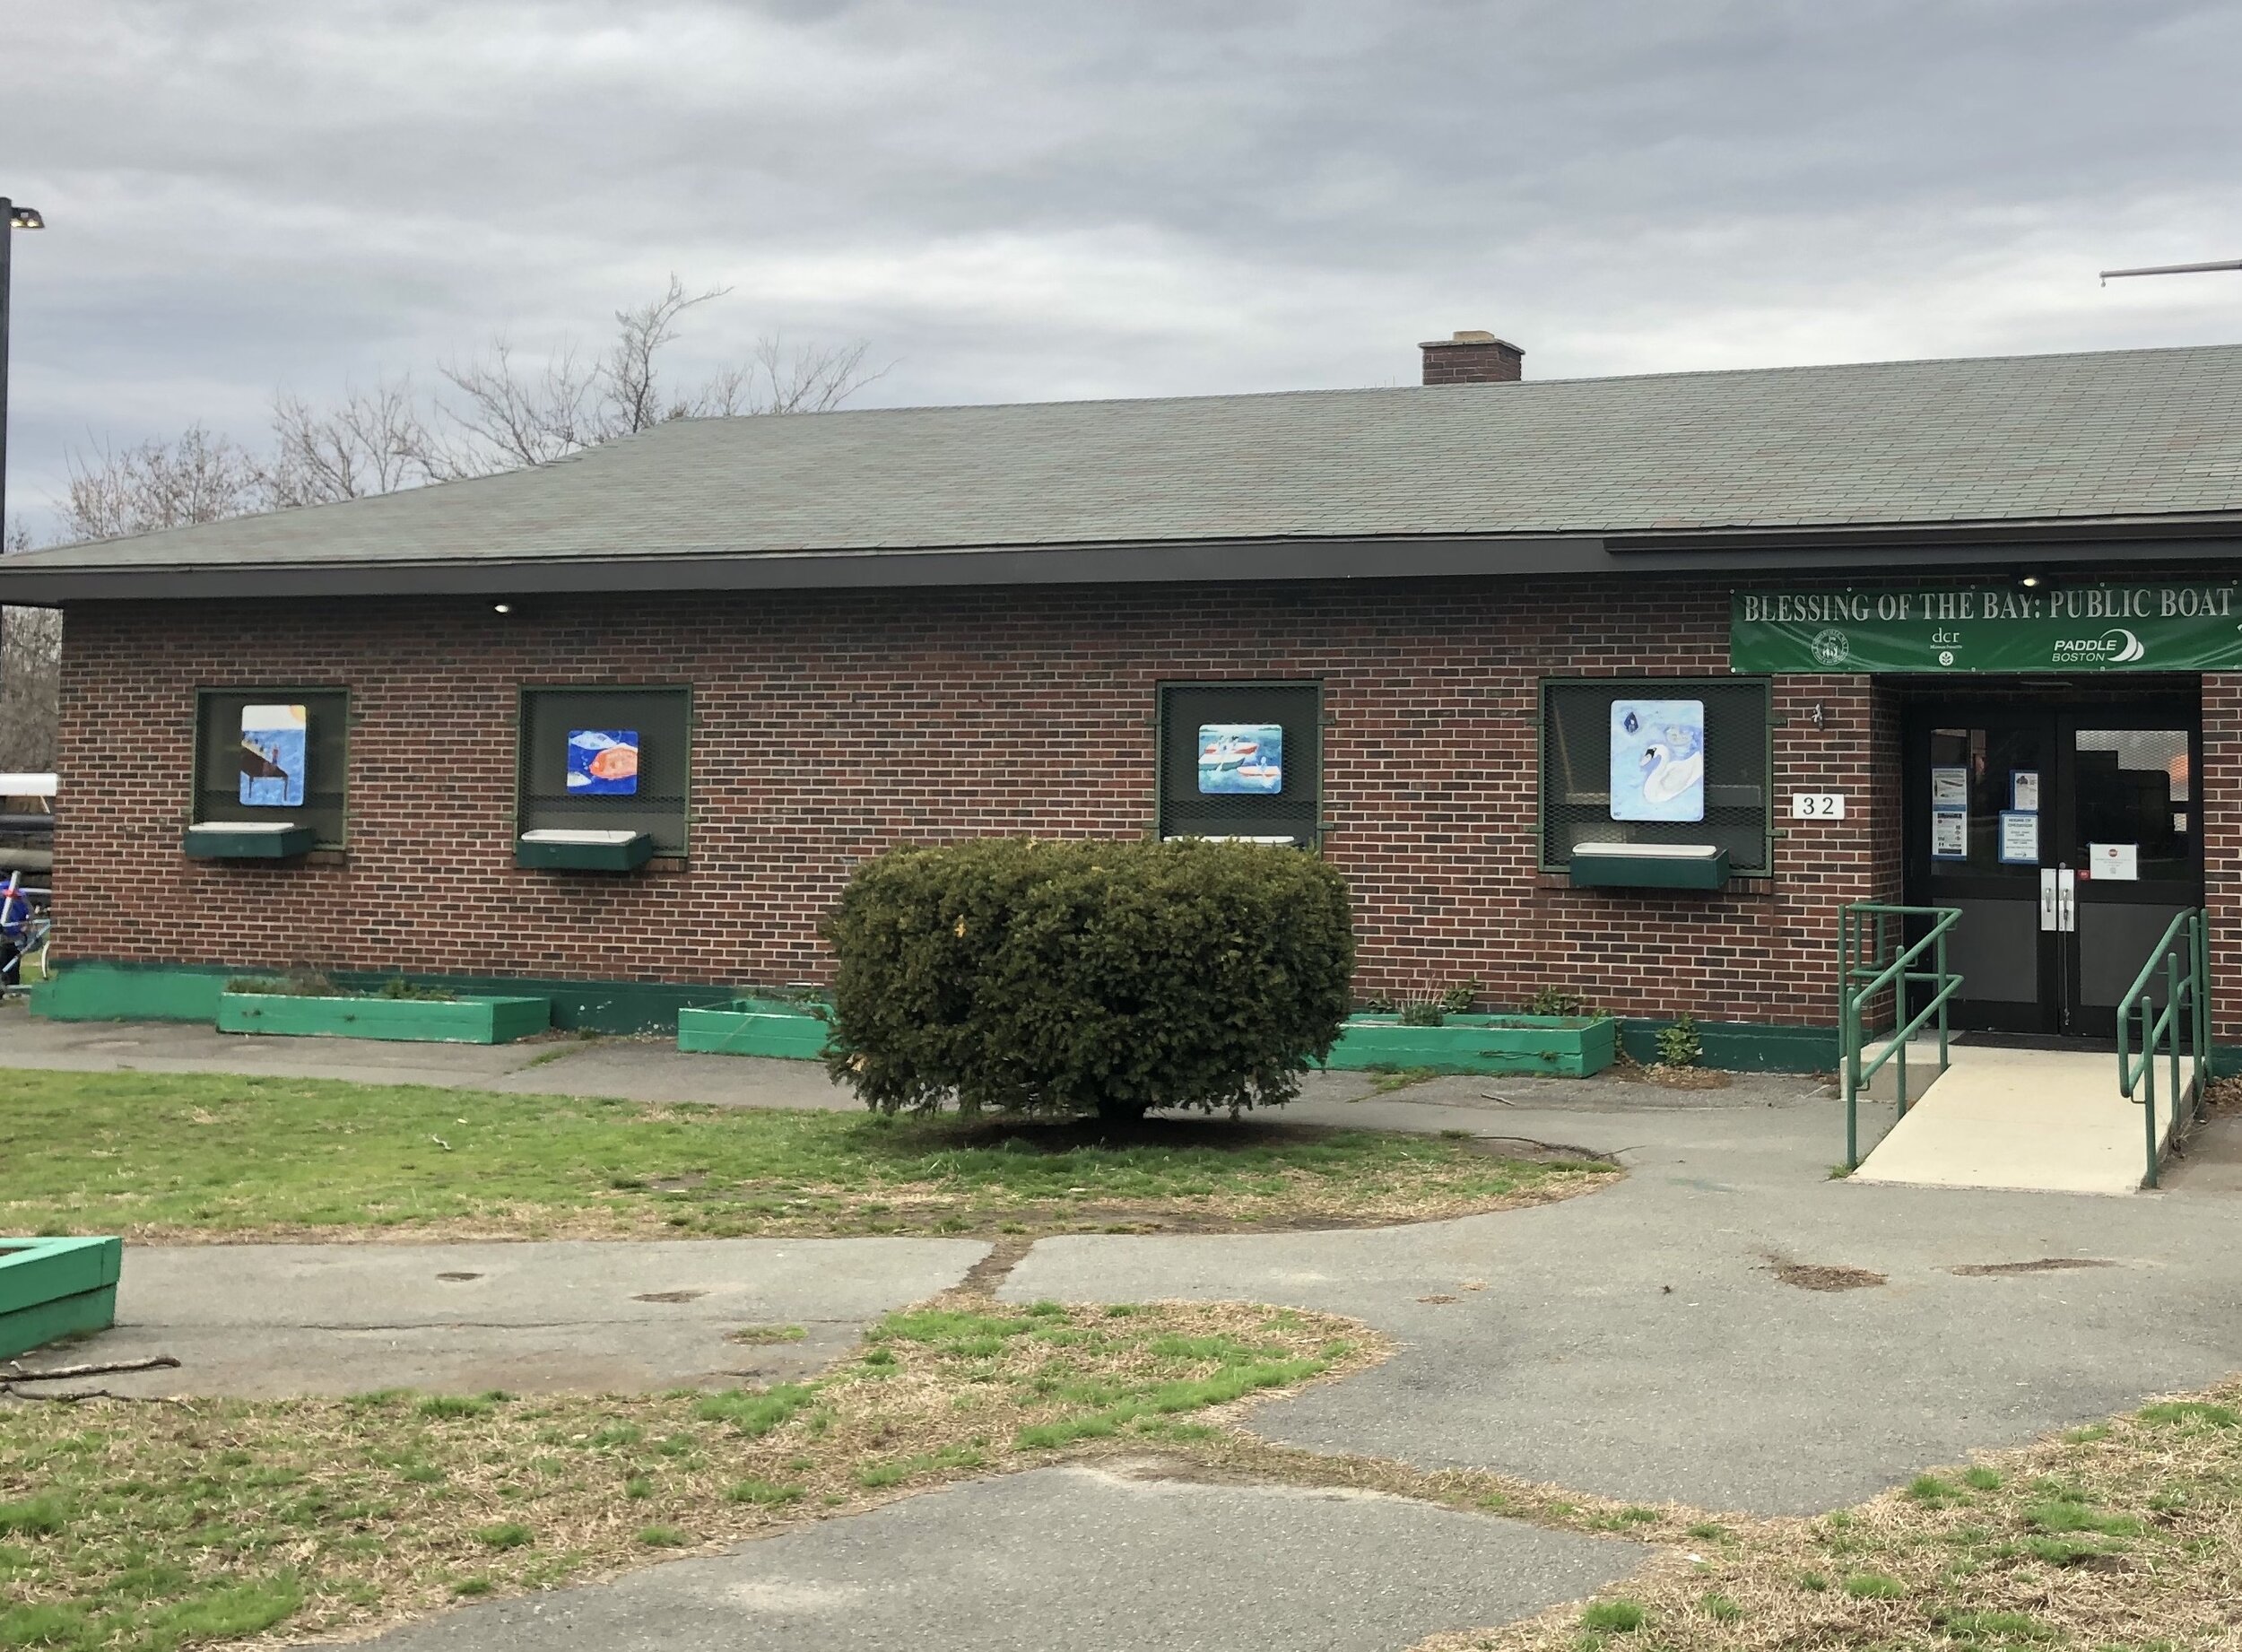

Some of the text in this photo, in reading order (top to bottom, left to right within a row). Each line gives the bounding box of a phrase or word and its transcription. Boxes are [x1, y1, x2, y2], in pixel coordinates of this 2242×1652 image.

[1743, 587, 2234, 622] BLESSING OF THE BAY: PUBLIC BOAT
[1932, 627, 1960, 643] dcr
[2054, 639, 2117, 651] PADDLE
[2051, 652, 2106, 663] BOSTON
